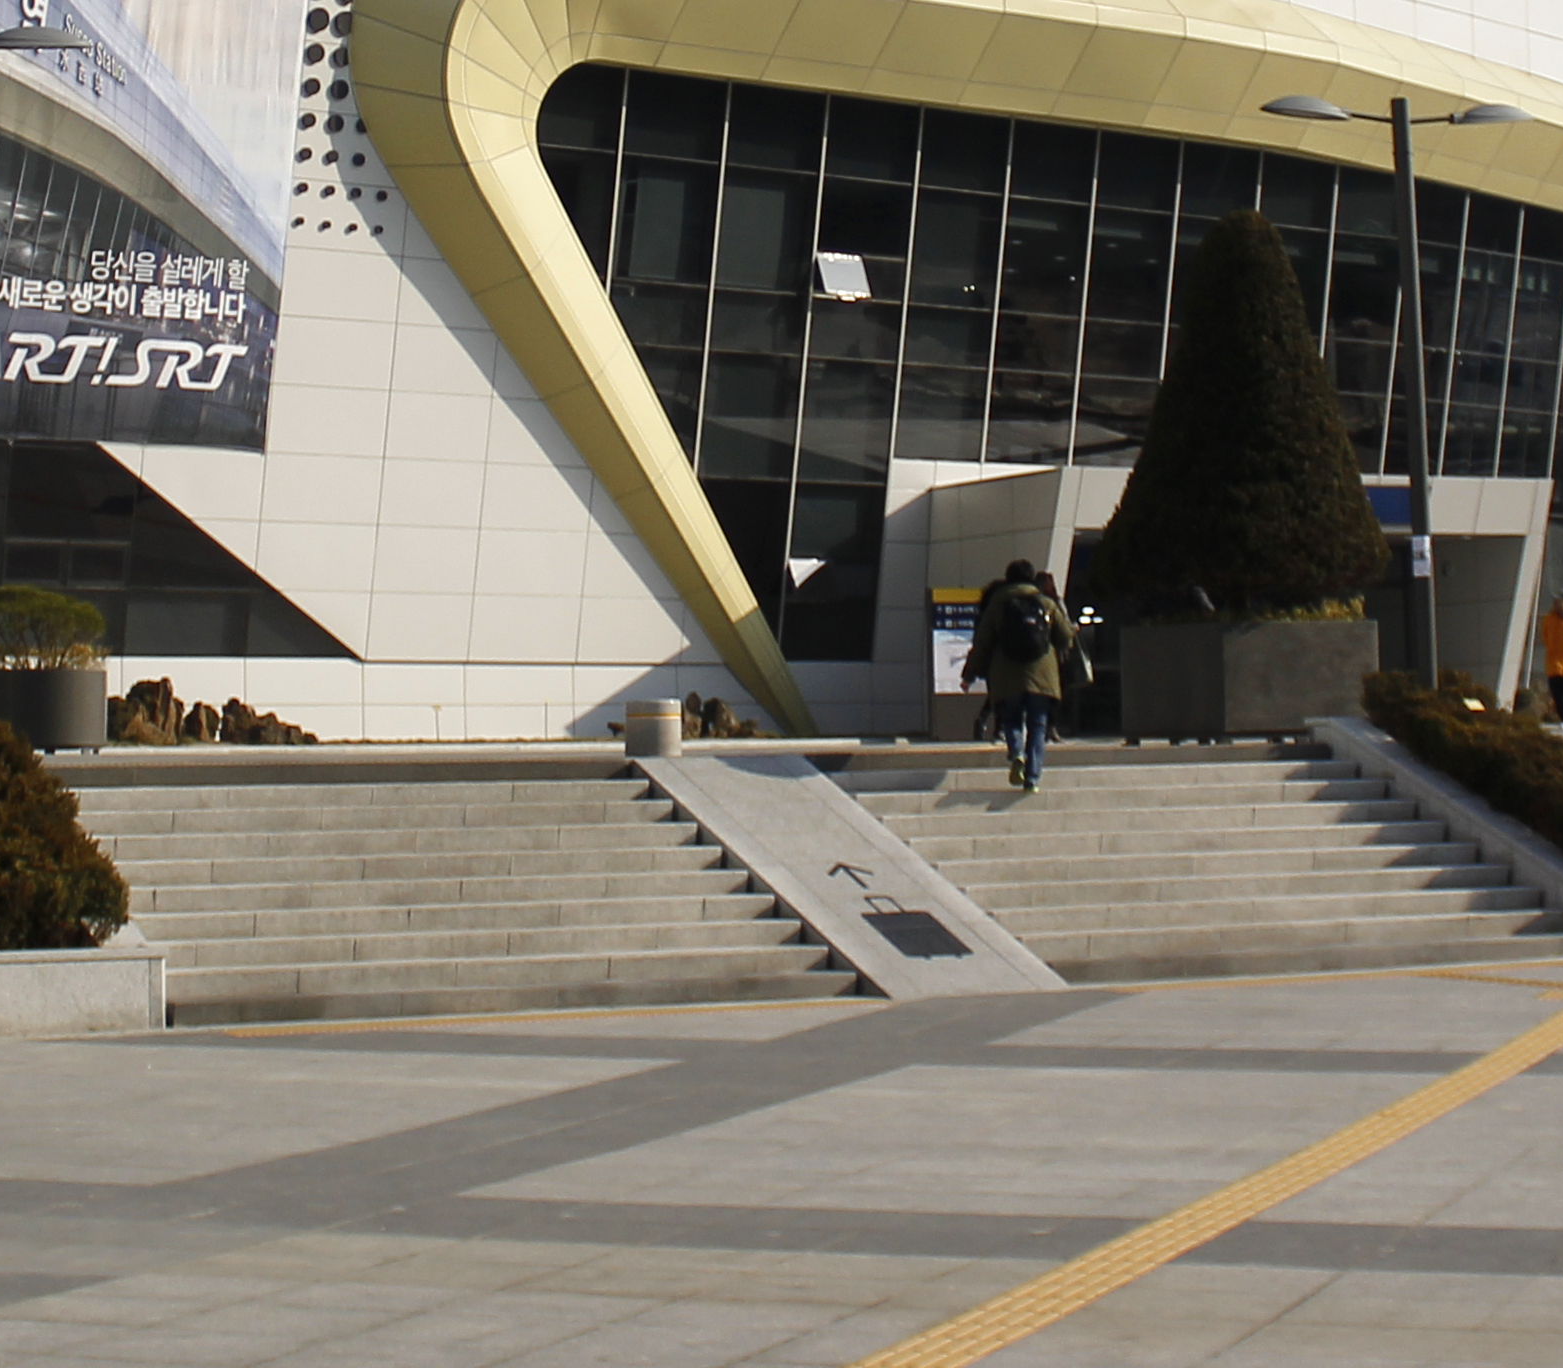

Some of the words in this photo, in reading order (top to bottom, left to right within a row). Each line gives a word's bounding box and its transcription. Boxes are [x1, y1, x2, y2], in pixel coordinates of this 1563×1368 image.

[90, 249, 157, 283] 당신을
[161, 252, 225, 288] 설레게
[227, 258, 250, 292] 할
[69, 281, 137, 317] 생각이
[140, 284, 247, 324] 출발합니다
